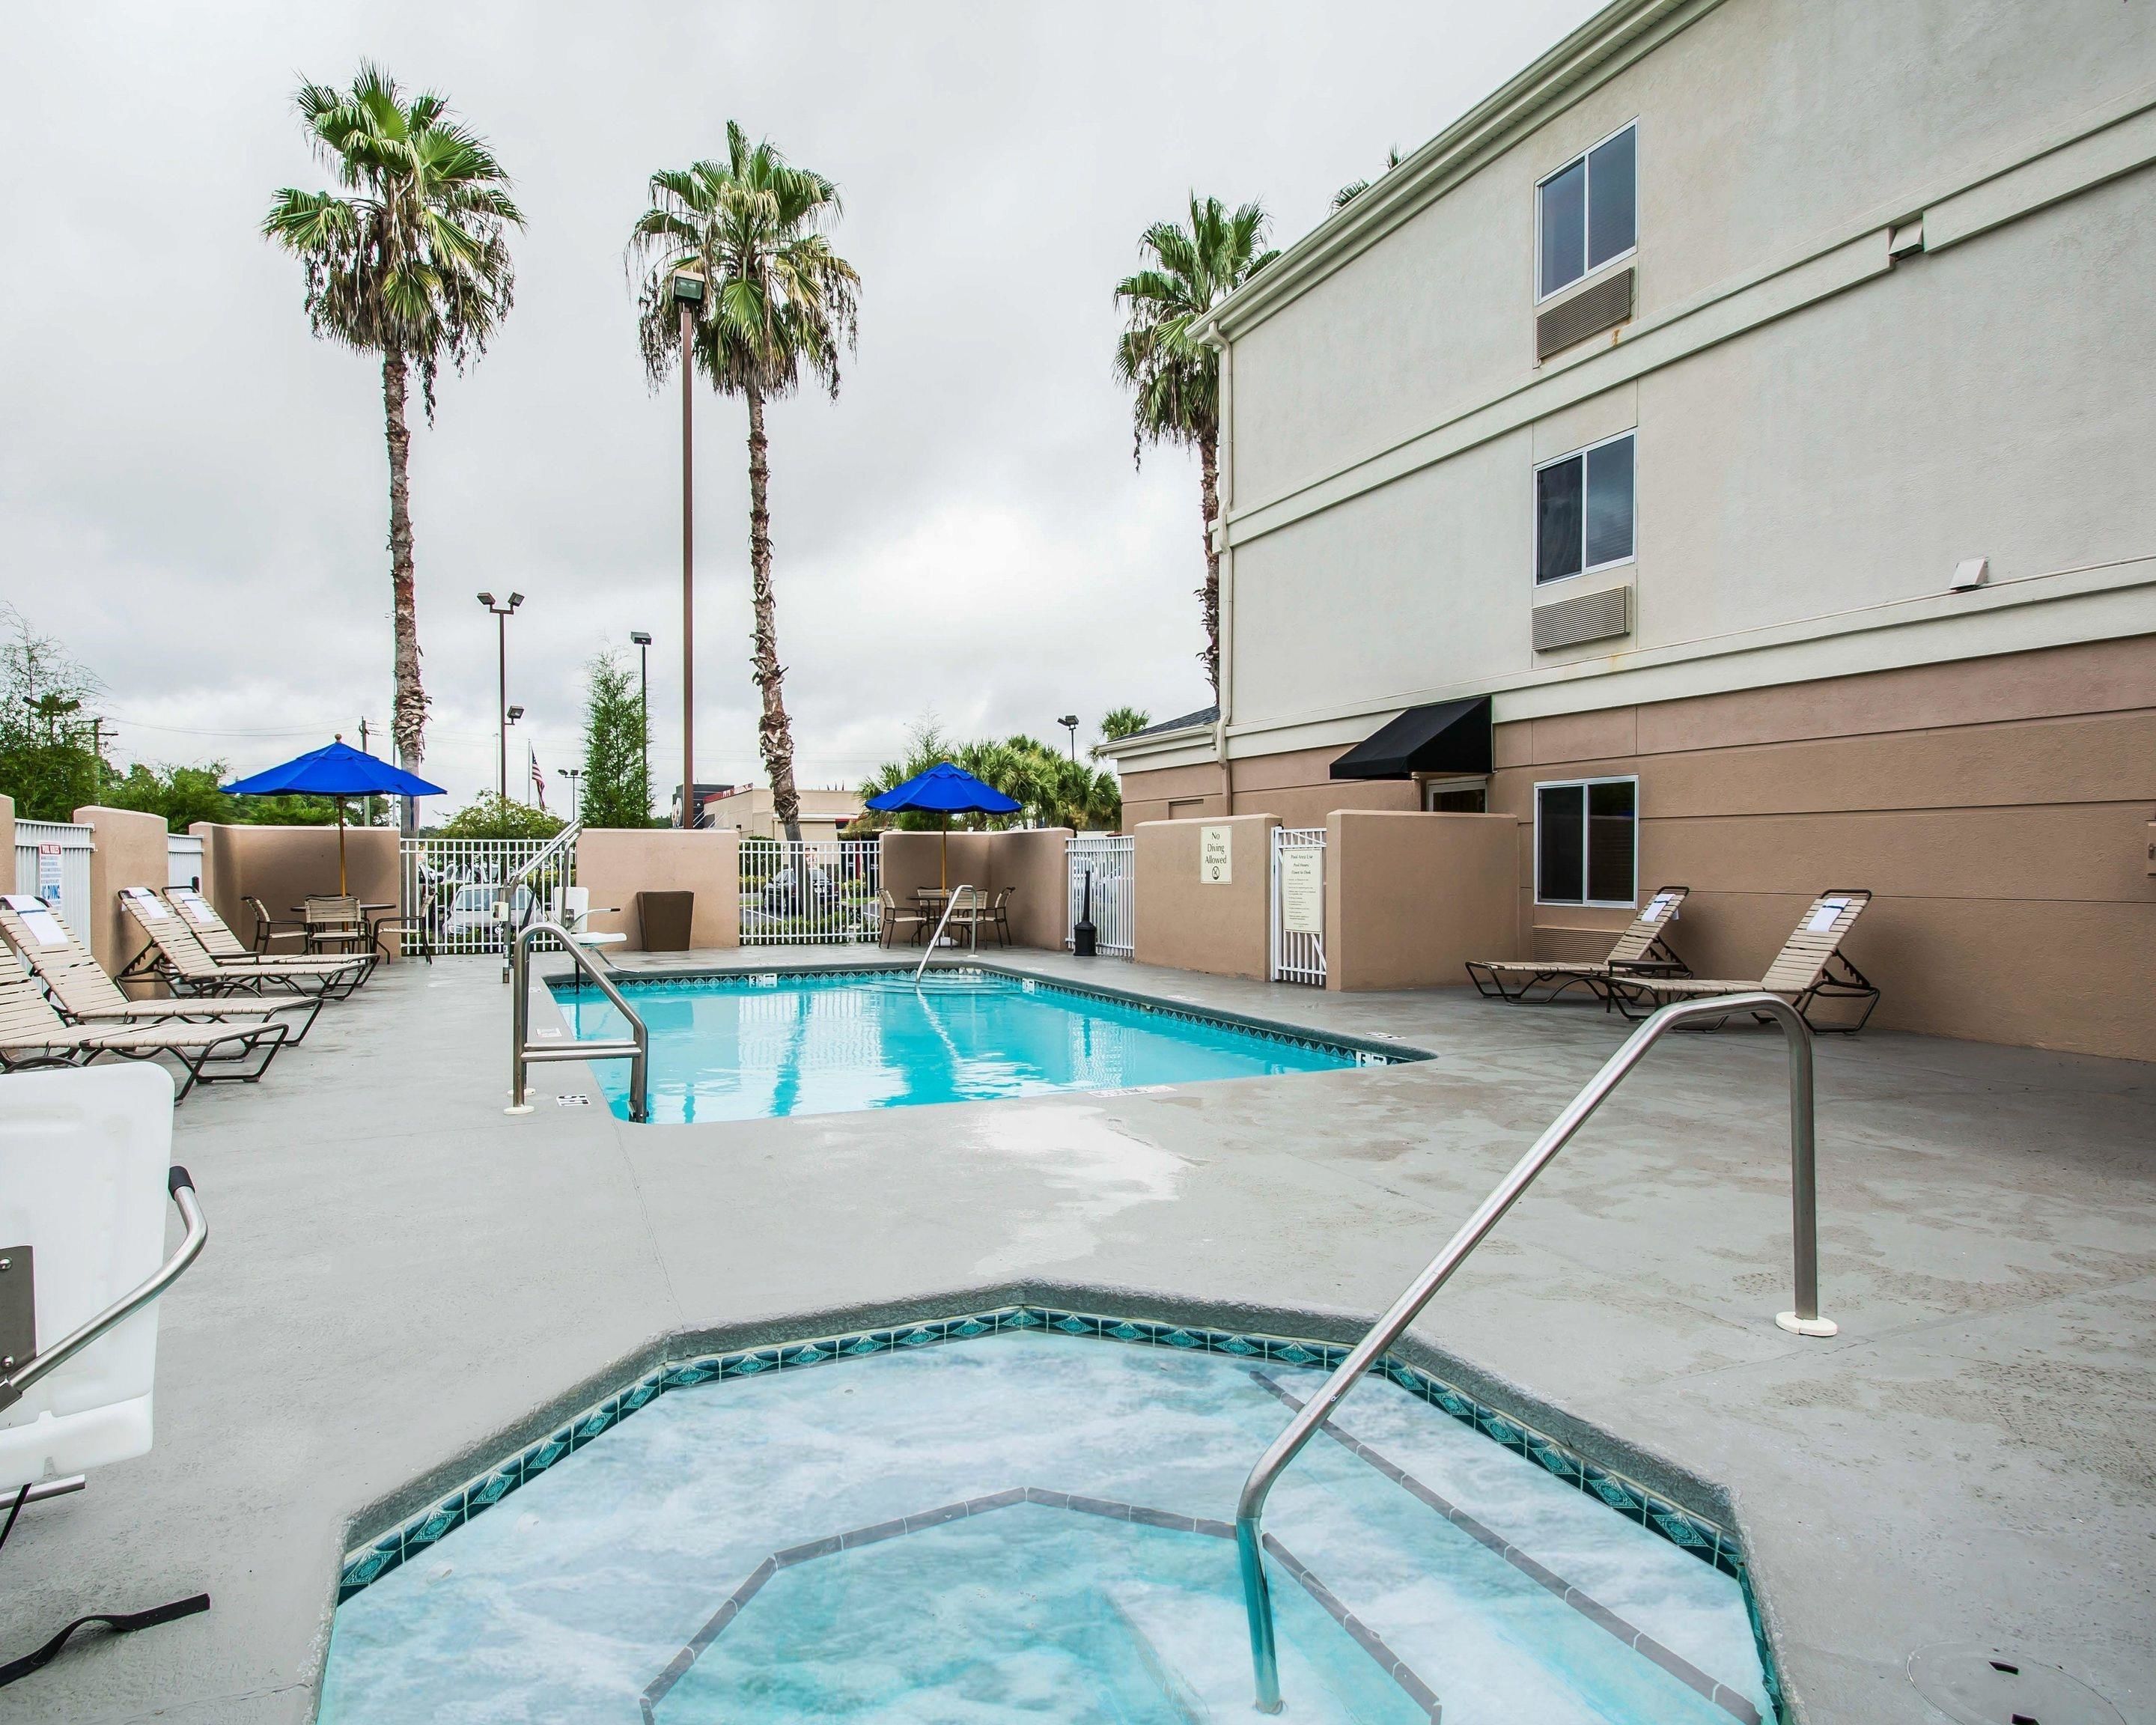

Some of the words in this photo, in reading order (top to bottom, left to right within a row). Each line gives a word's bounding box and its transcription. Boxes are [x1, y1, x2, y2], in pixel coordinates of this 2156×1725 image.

[1212, 832, 1220, 840] No
[1207, 843, 1225, 854] Diving
[1205, 854, 1227, 864] Allowed
